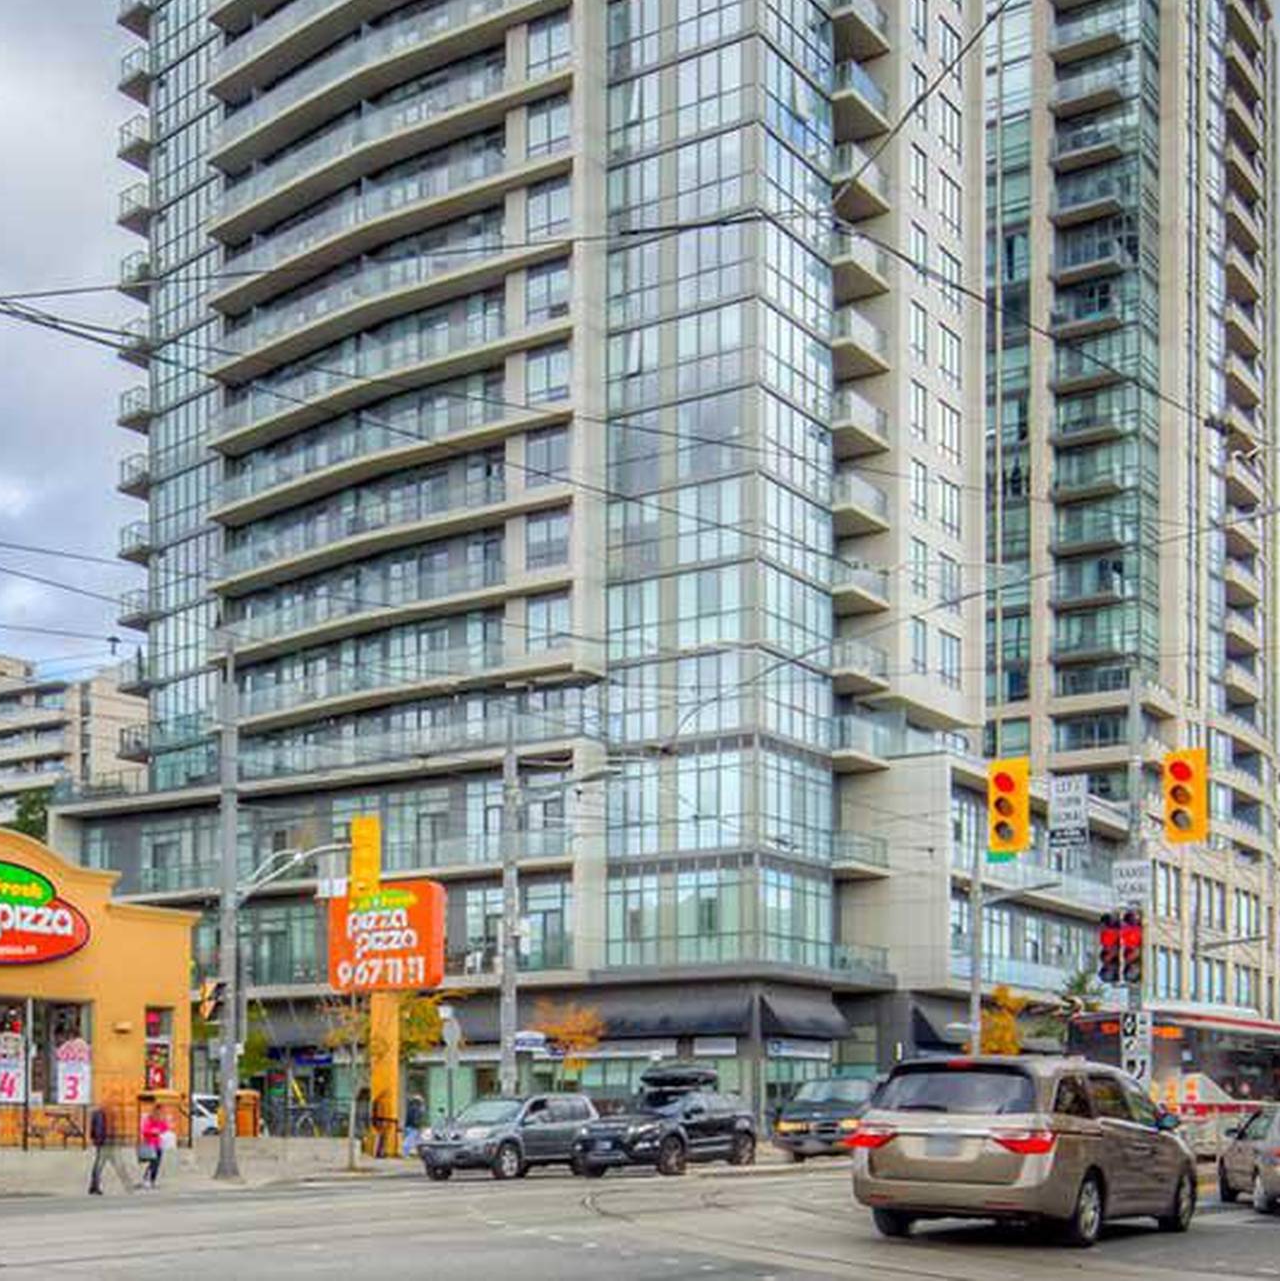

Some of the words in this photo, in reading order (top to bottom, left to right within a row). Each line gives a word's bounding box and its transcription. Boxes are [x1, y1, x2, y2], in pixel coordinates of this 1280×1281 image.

[348, 907, 408, 939] pizza
[354, 929, 418, 959] pizza
[64, 1075, 79, 1100] 3
